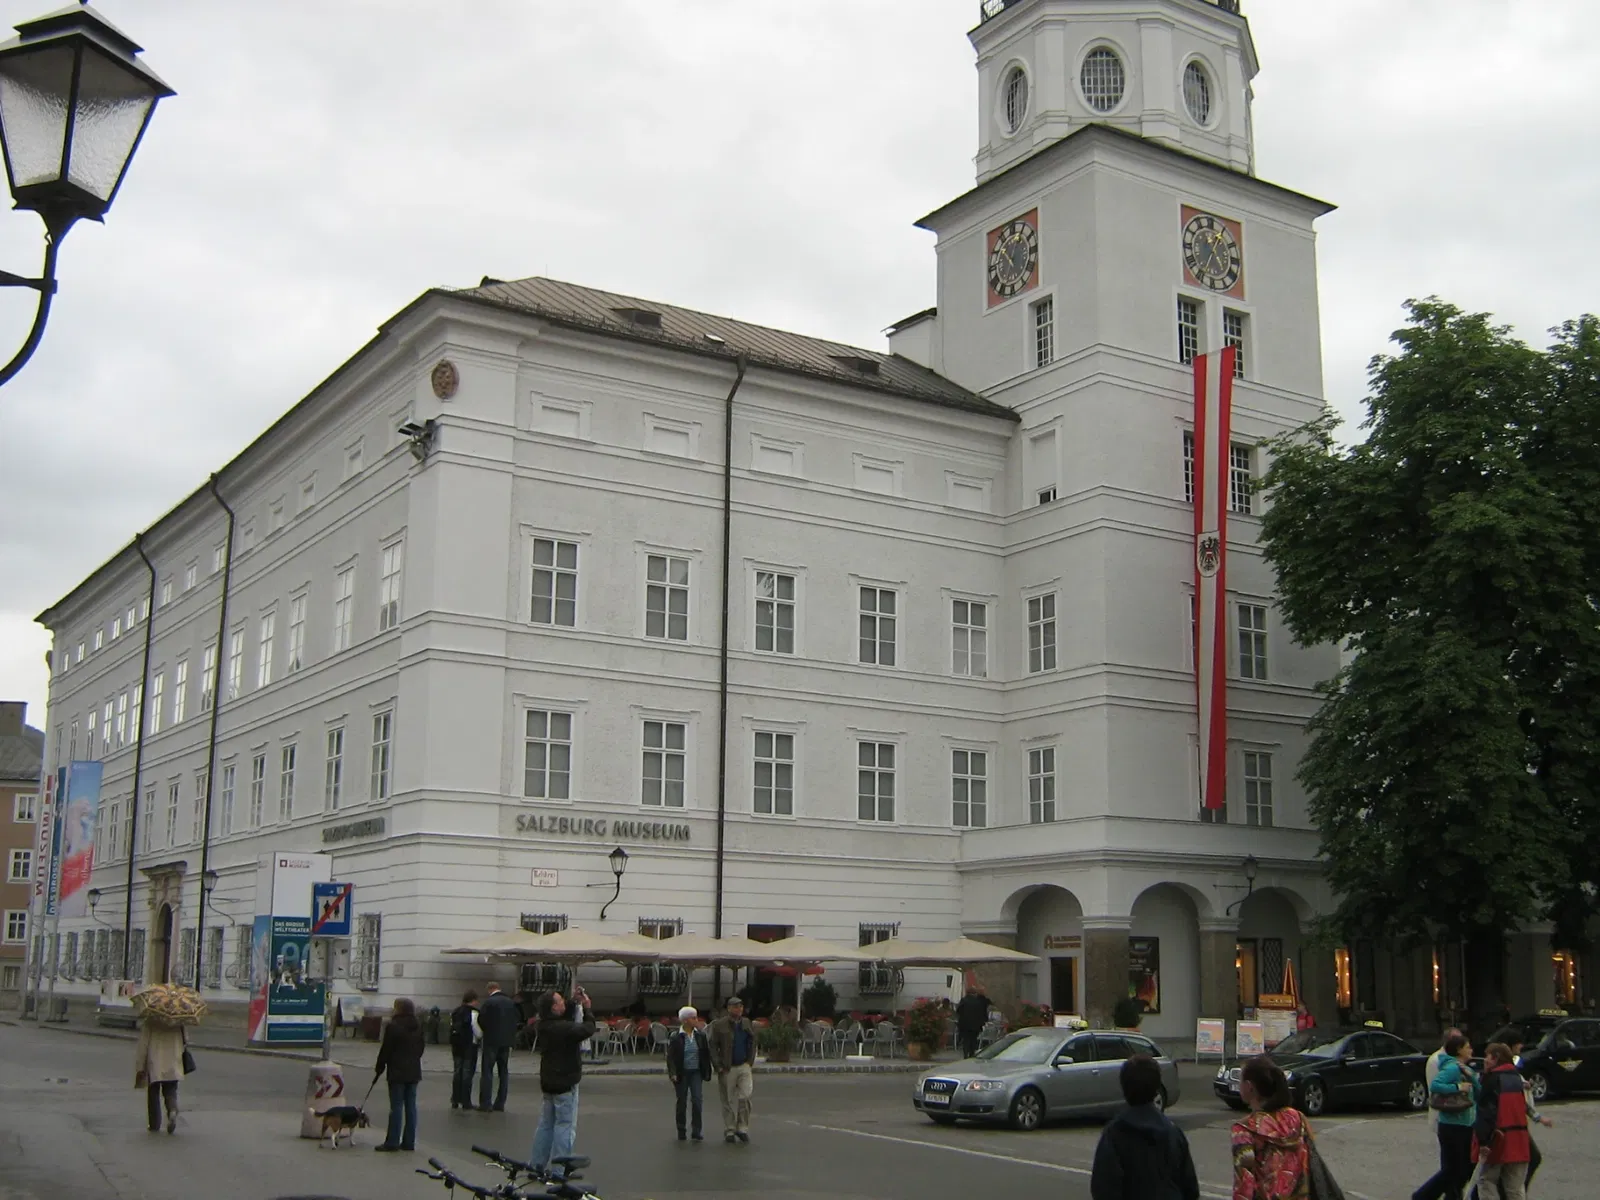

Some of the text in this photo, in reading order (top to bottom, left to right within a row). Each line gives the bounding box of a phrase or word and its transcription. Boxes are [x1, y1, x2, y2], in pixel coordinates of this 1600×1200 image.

[36, 811, 51, 896] MUSEUM
[515, 814, 691, 842] SALZBURG MUSEUM
